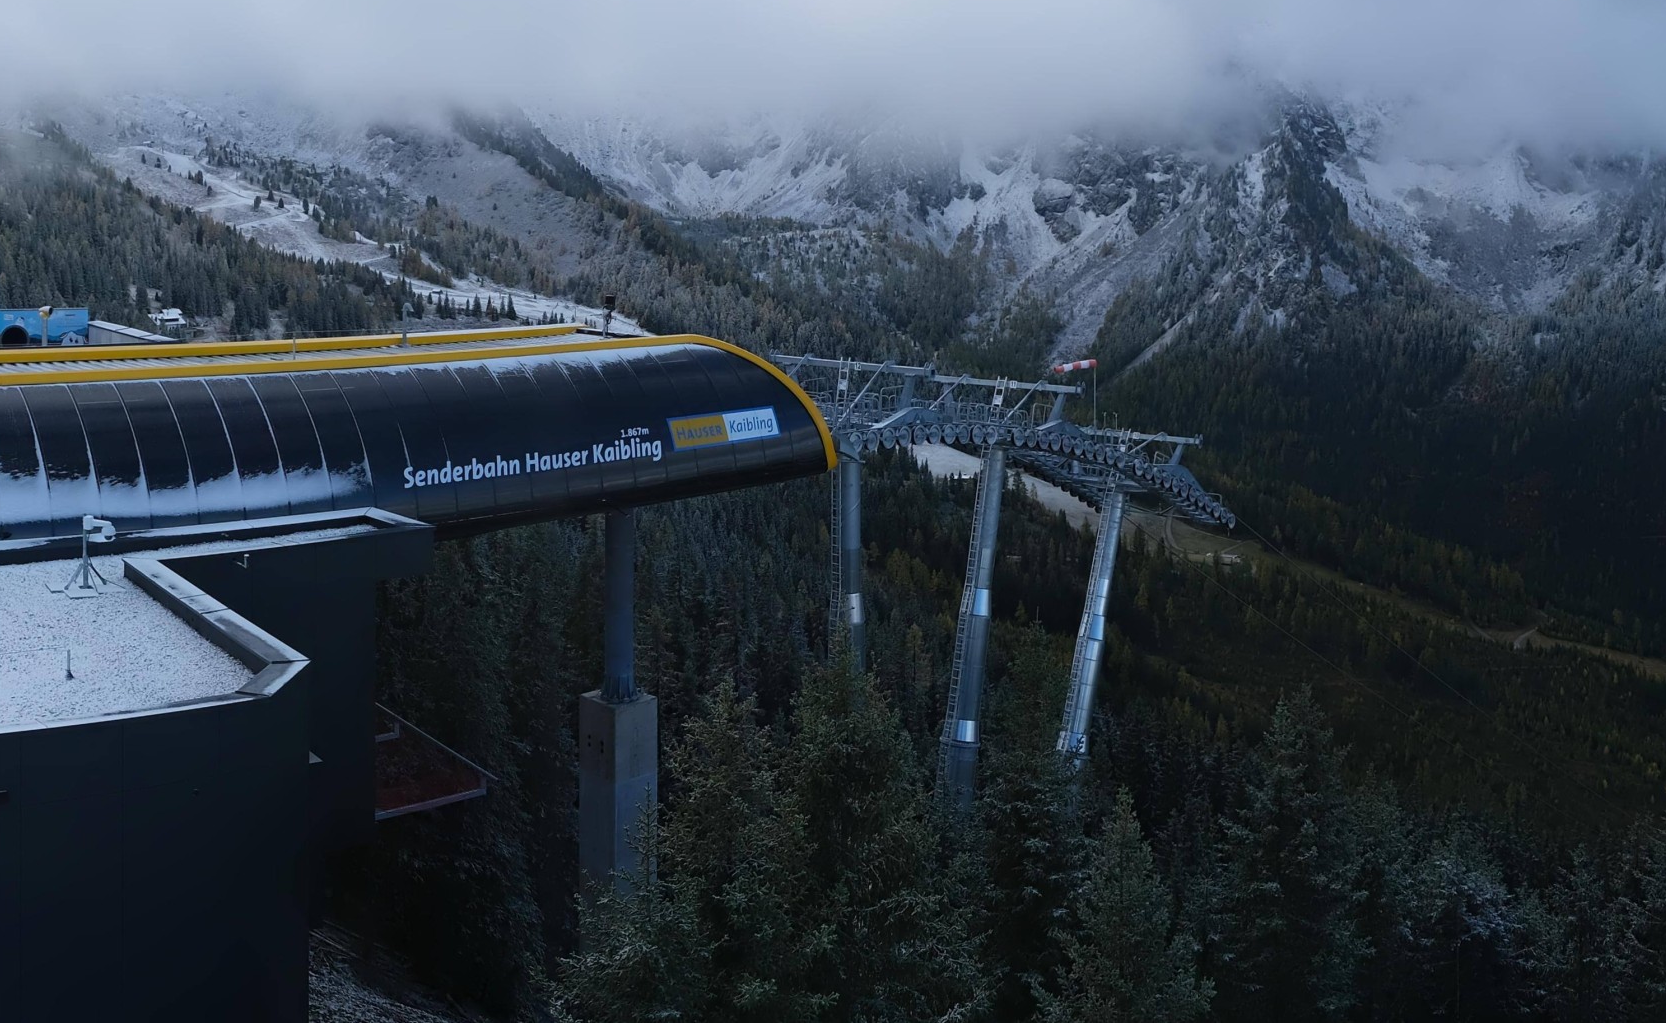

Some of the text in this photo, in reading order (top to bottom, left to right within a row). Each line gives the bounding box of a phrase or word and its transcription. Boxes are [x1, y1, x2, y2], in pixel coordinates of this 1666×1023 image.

[620, 427, 650, 438] 1.867m
[676, 414, 774, 442] HAUSER Kaibling
[403, 439, 663, 489] Senderbahn Hauser Kaibling
